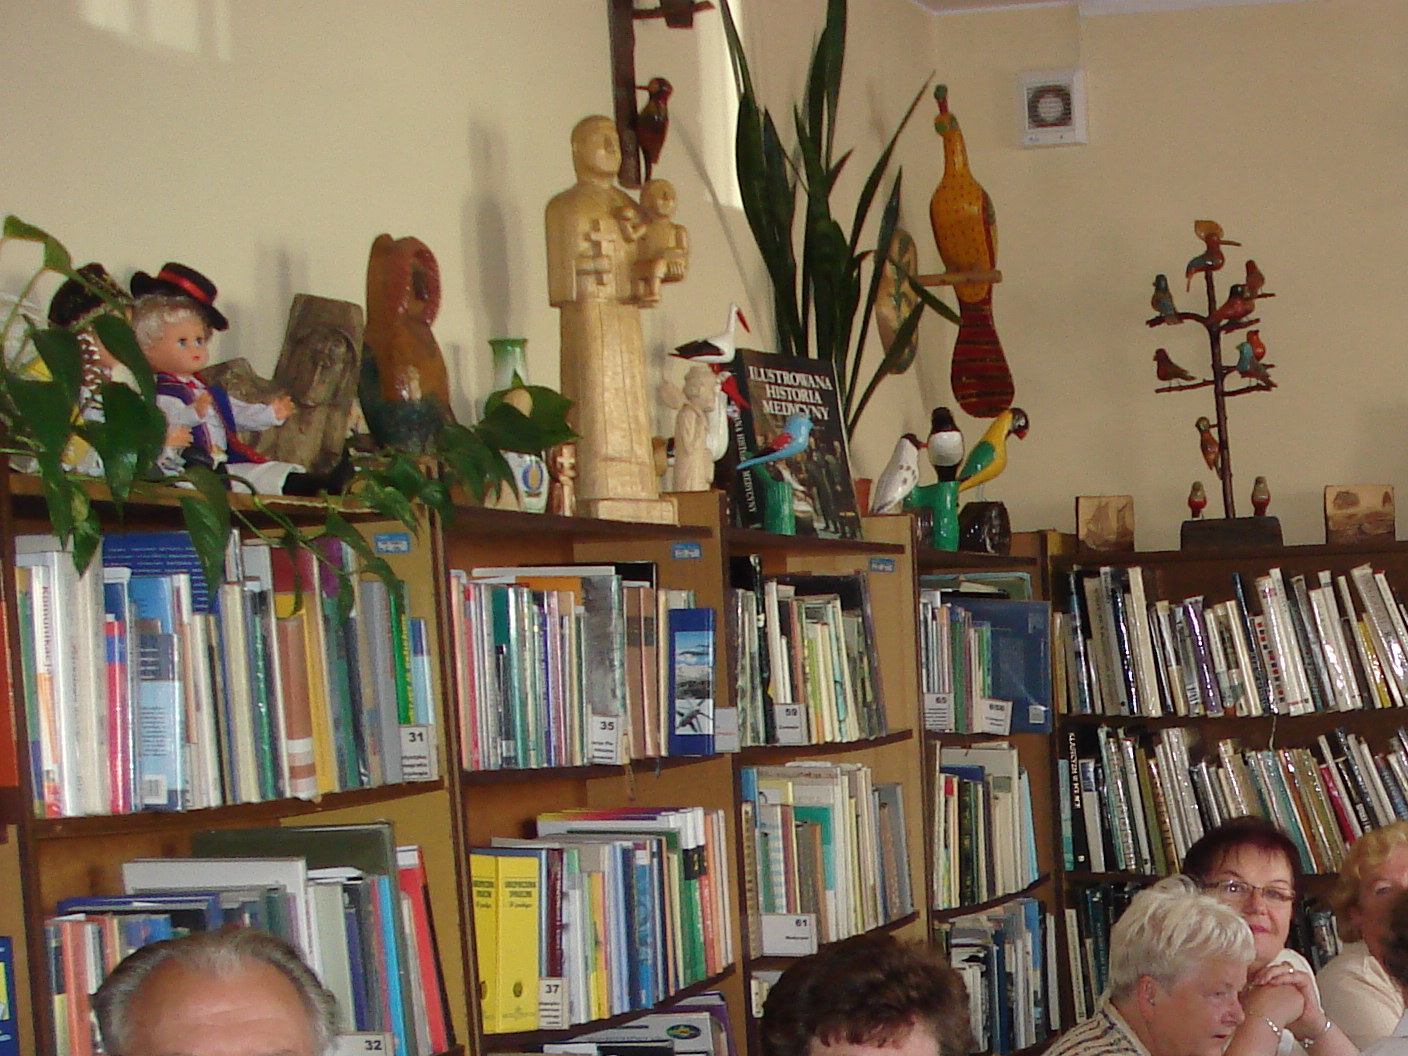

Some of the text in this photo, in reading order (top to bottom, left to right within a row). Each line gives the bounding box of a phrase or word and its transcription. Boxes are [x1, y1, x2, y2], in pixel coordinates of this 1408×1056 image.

[748, 366, 833, 390] ILUSTROWANA
[765, 384, 823, 404] HISTORIA
[600, 721, 614, 731] 35
[408, 732, 424, 742] 31
[795, 918, 808, 927] 61
[545, 984, 559, 994] 37
[365, 1040, 382, 1050] 32
